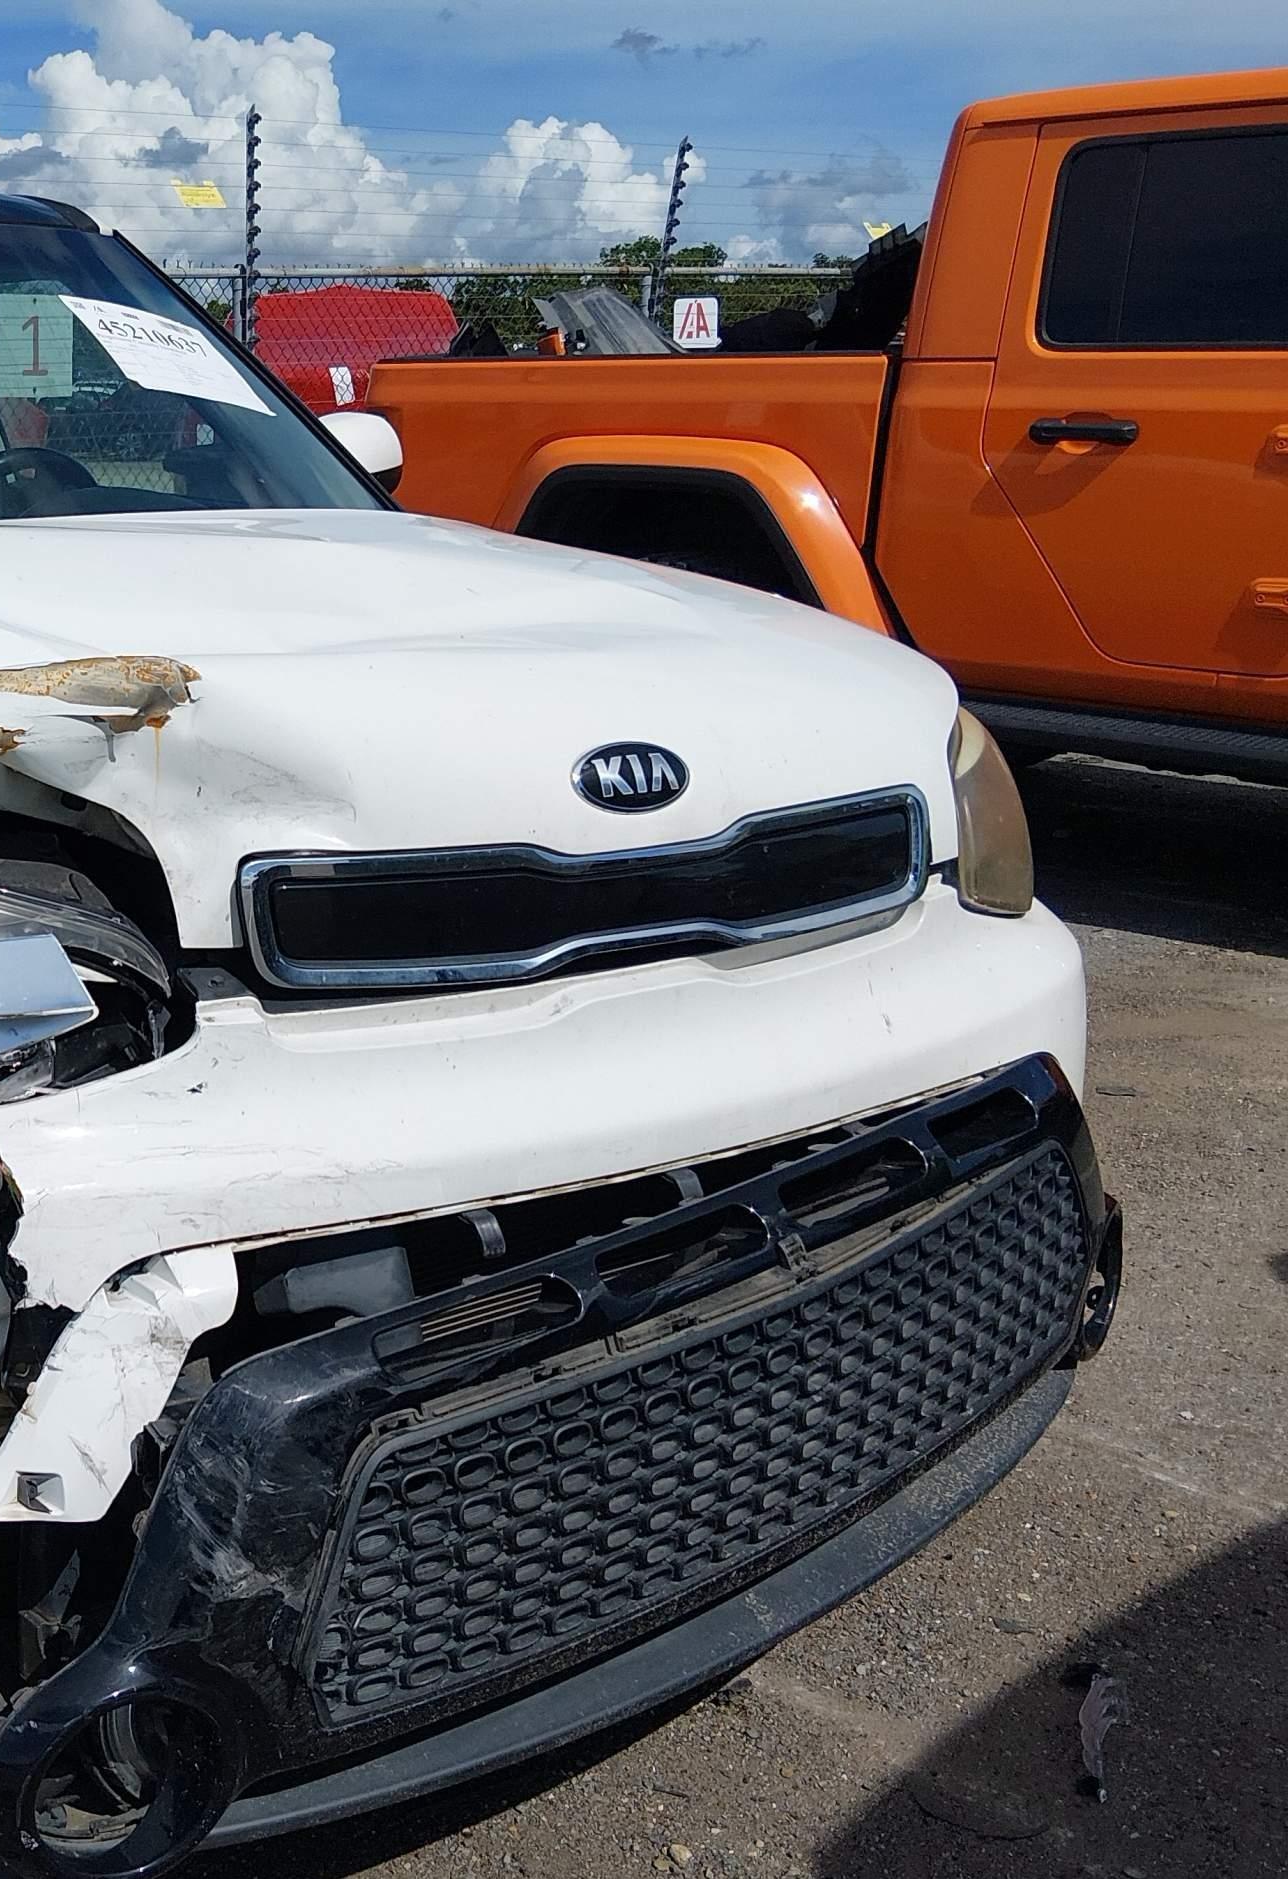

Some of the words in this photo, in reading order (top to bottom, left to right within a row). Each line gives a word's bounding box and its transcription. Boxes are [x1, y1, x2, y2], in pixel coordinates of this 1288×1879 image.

[22, 316, 49, 377] 1
[98, 319, 207, 357] 45210637
[591, 753, 680, 797] KIA
